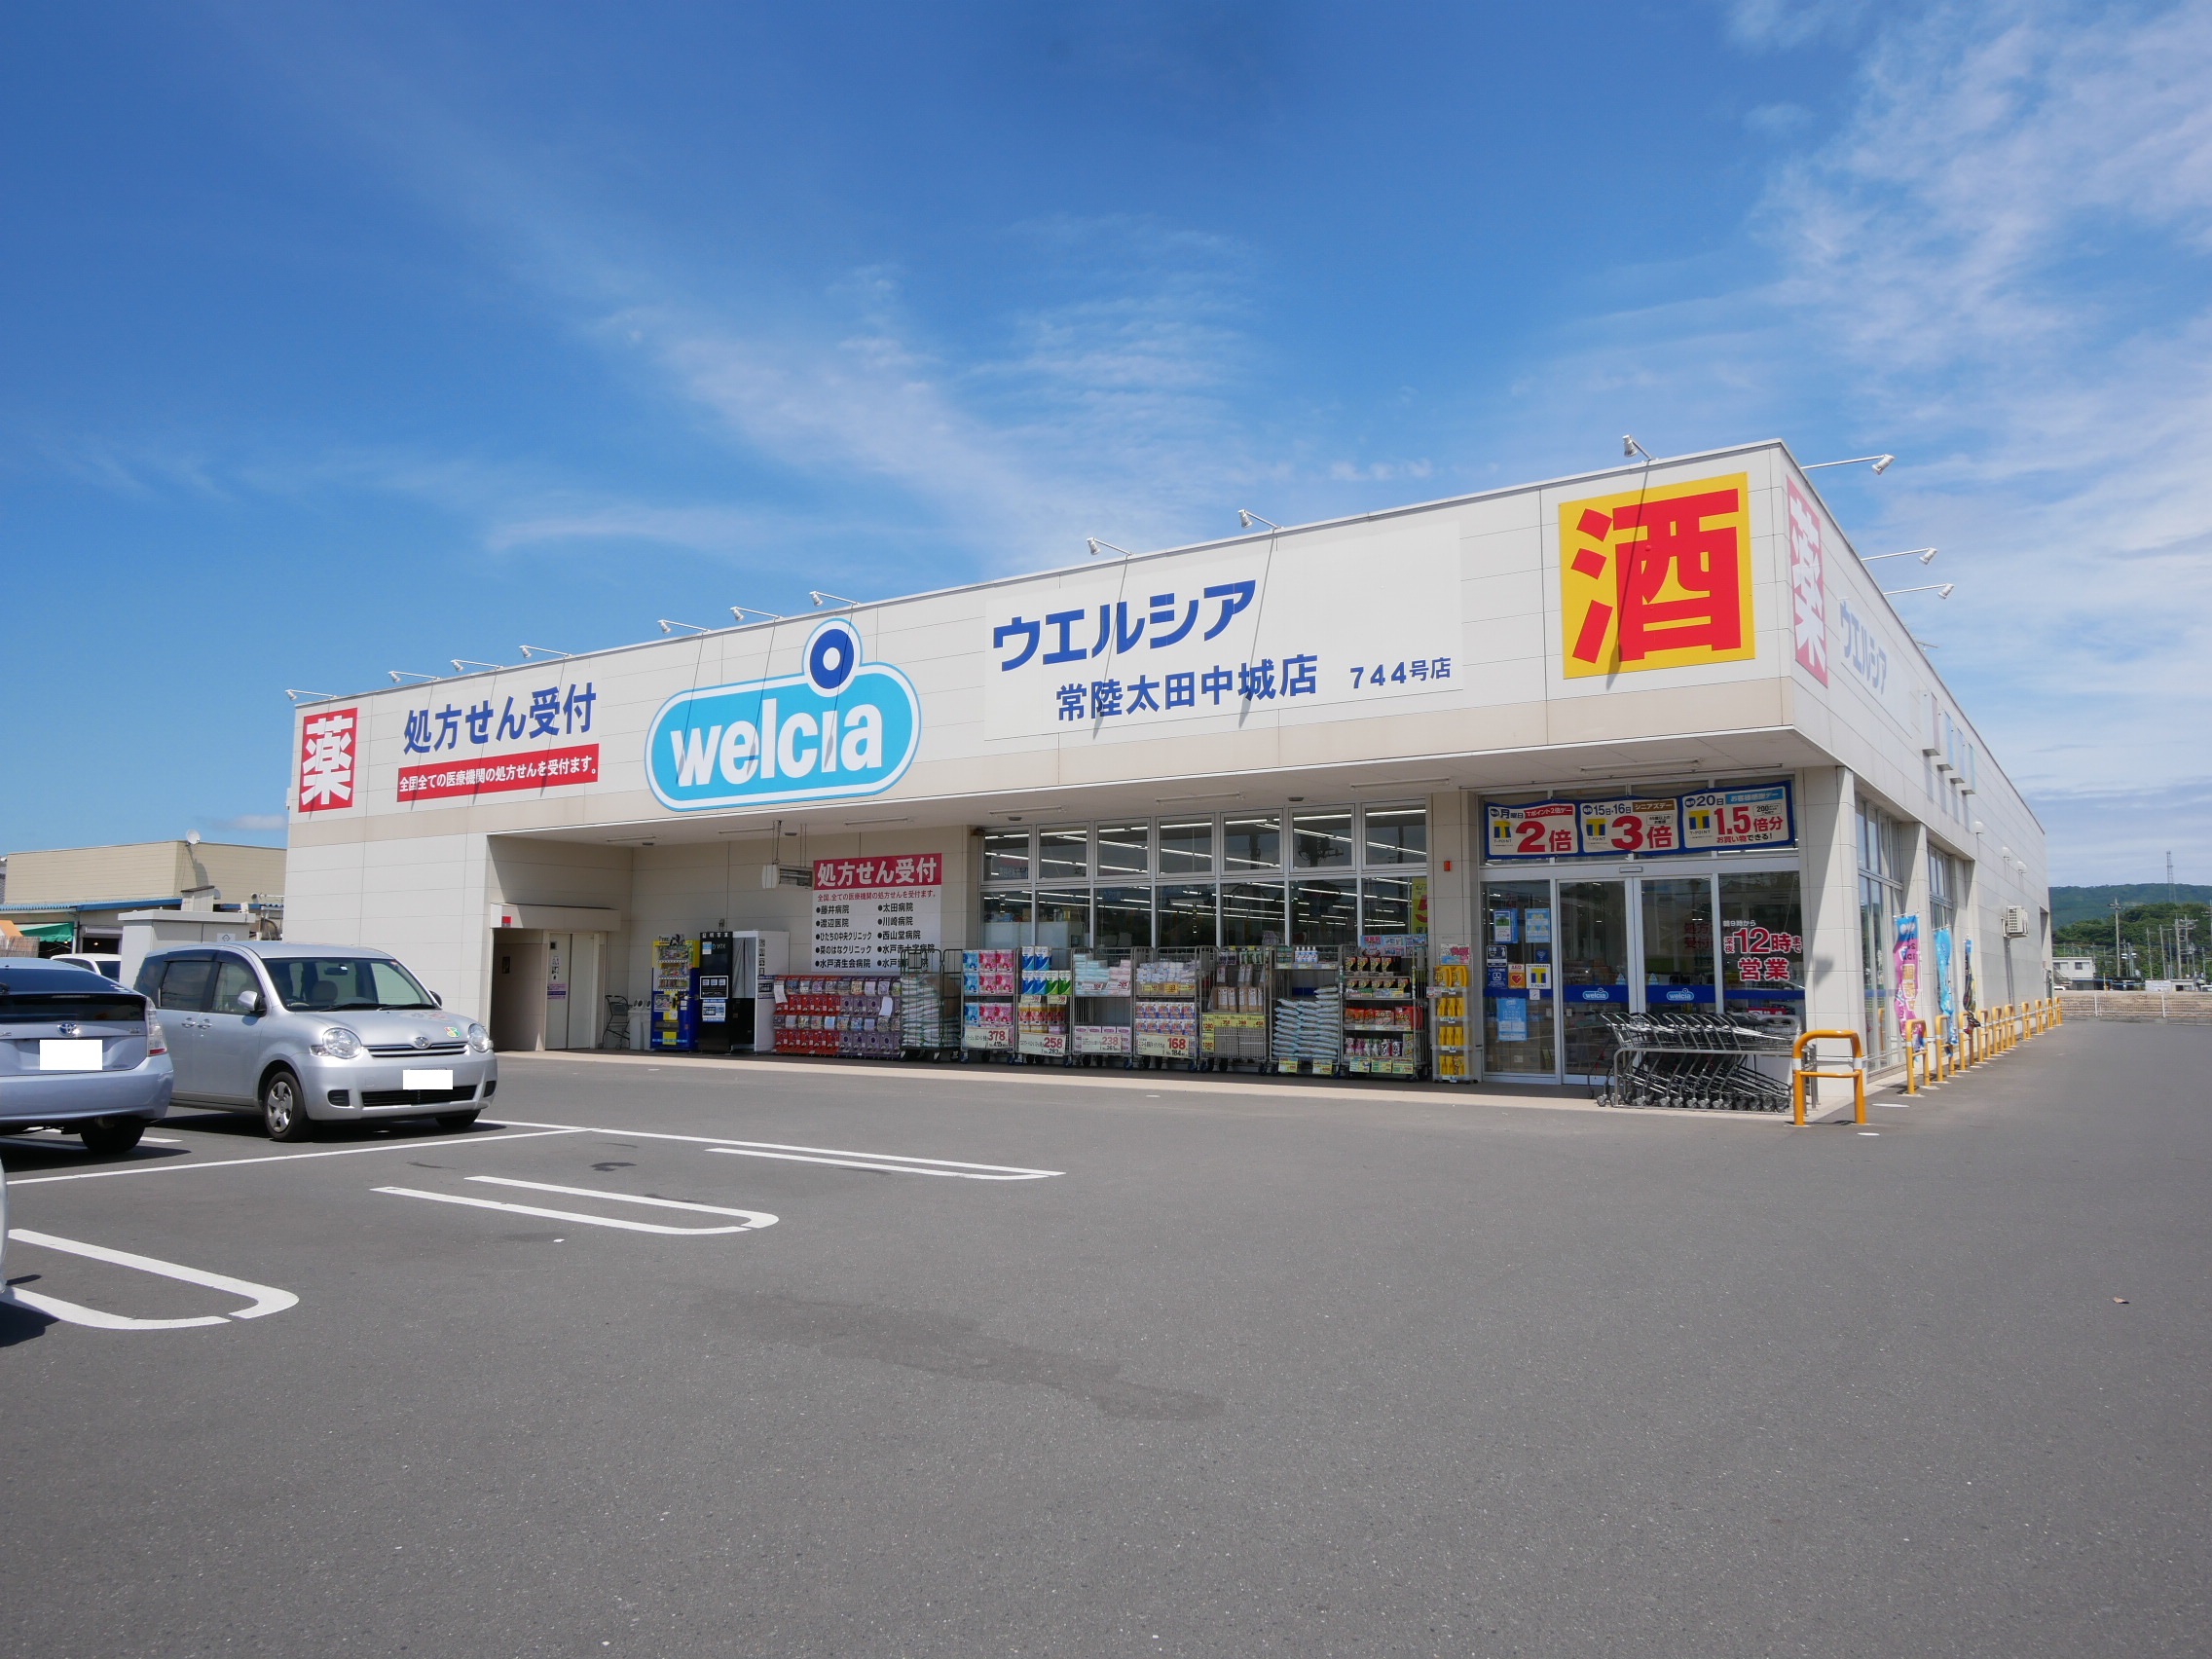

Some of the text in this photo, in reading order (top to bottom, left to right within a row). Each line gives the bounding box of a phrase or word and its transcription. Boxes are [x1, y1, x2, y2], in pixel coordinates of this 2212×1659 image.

[1571, 488, 1742, 663] 酒
[1789, 494, 1826, 673] 薬
[993, 579, 1257, 673] ウエルシア
[1839, 600, 1887, 695] ウエルシア
[1055, 653, 1452, 721] 常陸太田中城店 744号店
[402, 682, 597, 756] 処方せん受付
[669, 697, 884, 787] welcia
[301, 716, 353, 806] 薬
[398, 756, 597, 793] 全国全ての医療機関の処方せんを受付ます。
[1515, 820, 1572, 853] 2倍
[1610, 815, 1673, 851] 3倍
[1714, 806, 1784, 835] 1.5倍分
[817, 857, 938, 888] 処方せん受付
[882, 916, 913, 927] 川崎病院
[1738, 957, 1790, 981] 営業
[987, 1030, 1006, 1042] 378
[1043, 1037, 1063, 1049] 258
[1101, 1036, 1119, 1046] 238
[1166, 1037, 1186, 1050] 168
